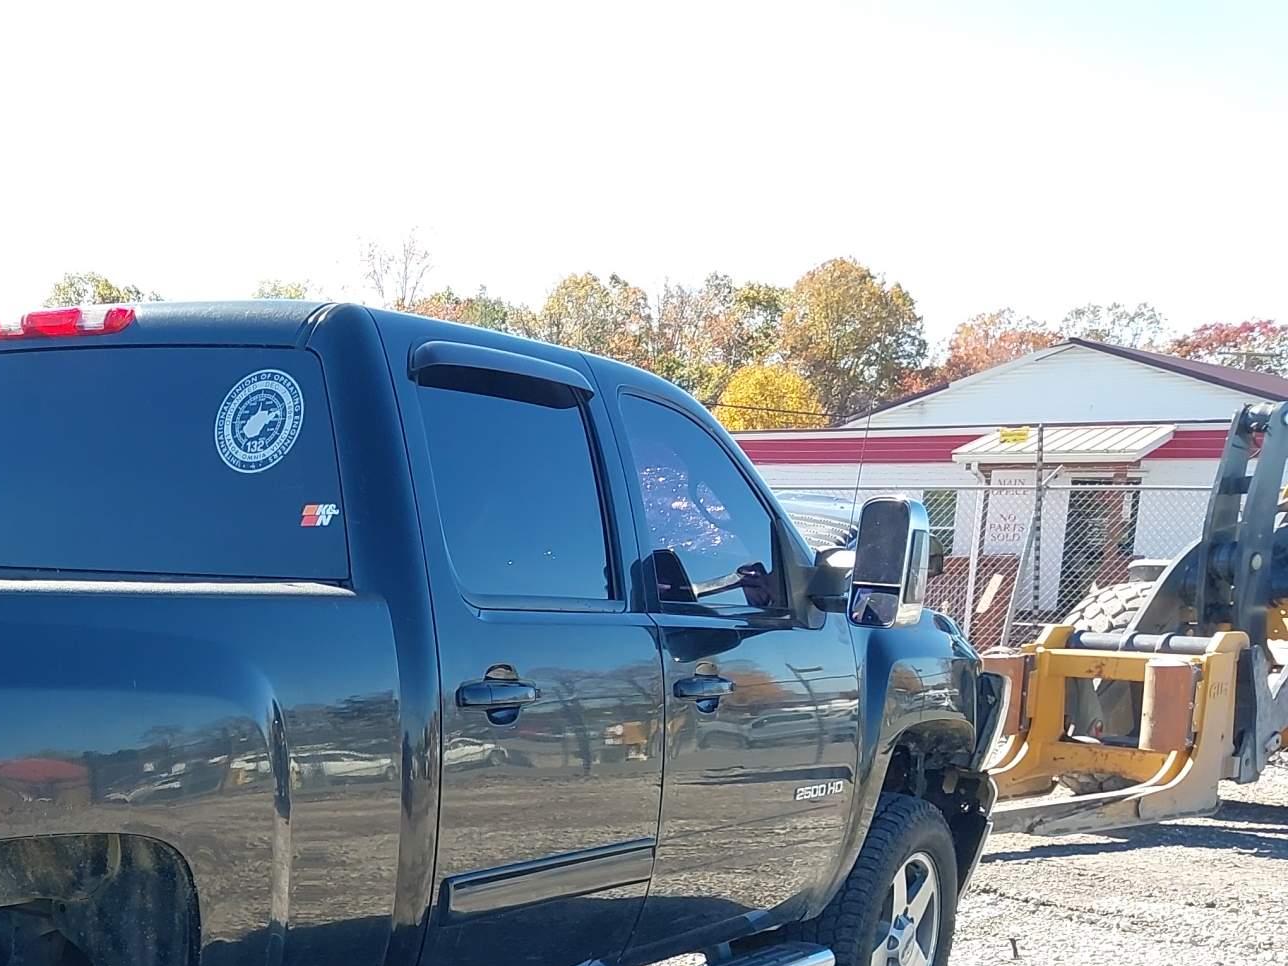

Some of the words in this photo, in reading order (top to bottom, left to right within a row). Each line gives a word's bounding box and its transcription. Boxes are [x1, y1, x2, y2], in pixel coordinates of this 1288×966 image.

[231, 375, 258, 399] UNION
[260, 373, 273, 381] OF
[274, 374, 301, 411] OPERATING
[246, 440, 265, 453] 132
[999, 514, 1016, 522] NO
[989, 523, 1025, 532] PARTS
[990, 533, 1021, 542] SOLD
[796, 784, 827, 801] 2500
[827, 780, 844, 795] HD
